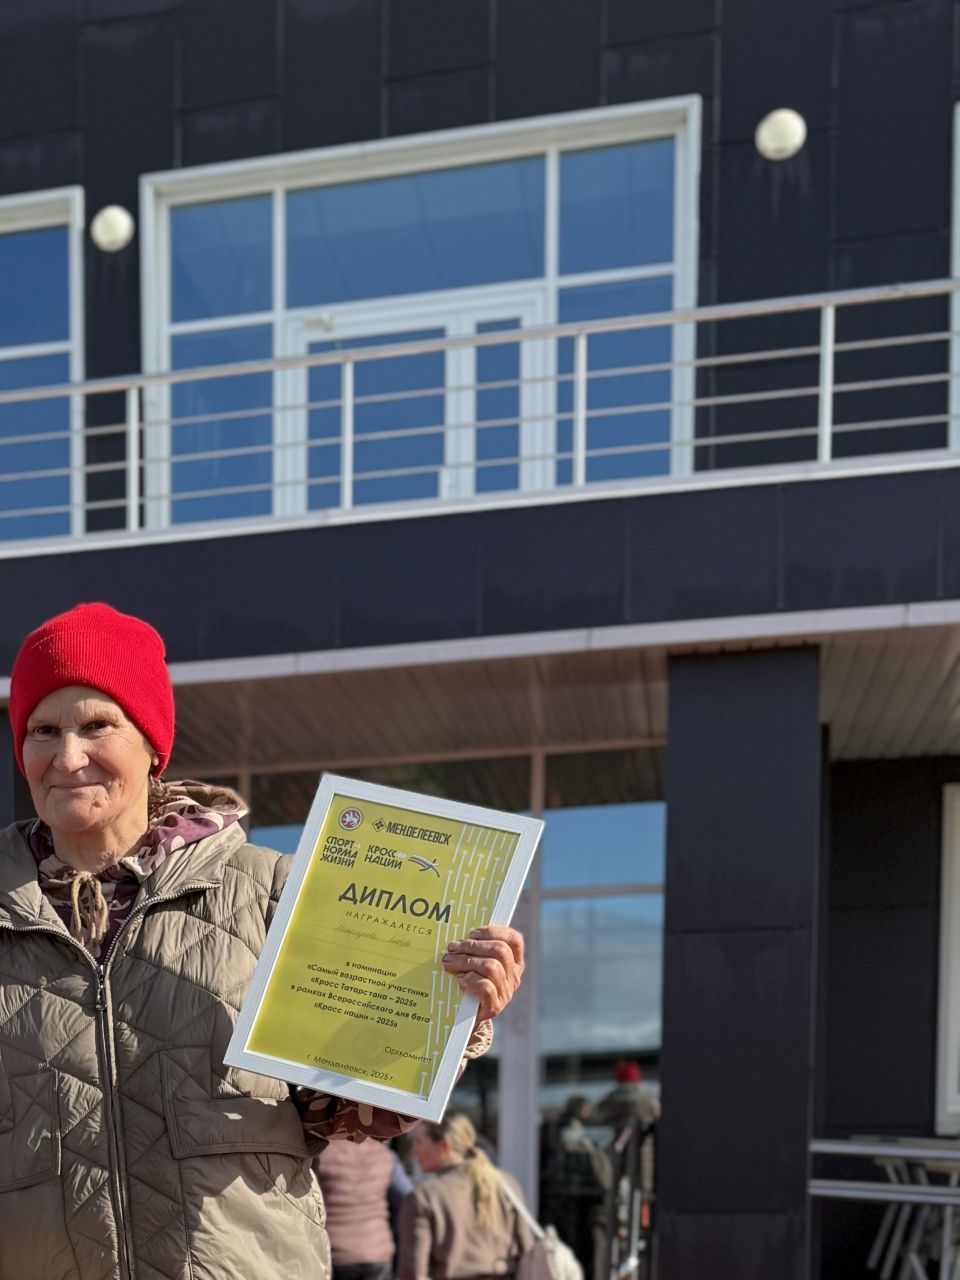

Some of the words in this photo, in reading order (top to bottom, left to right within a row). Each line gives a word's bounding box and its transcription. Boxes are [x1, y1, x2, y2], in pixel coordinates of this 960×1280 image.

[386, 822, 452, 845] МЕНДЕЛЕЕВСК
[326, 836, 355, 848] СПОРТ
[323, 844, 358, 859] НОРМА
[367, 844, 398, 858] КРОСС
[320, 853, 355, 868] ЖИЗНИ
[364, 854, 403, 870] НАЦИИ
[338, 883, 451, 923] ДИПЛОМ
[345, 910, 432, 936] НАГРАЖДАЕТСЯ
[352, 962, 397, 978] номинации
[340, 972, 386, 987] возрастной
[341, 983, 388, 1000] Татарстана
[296, 984, 326, 998] рамках
[328, 992, 394, 1014] Всероссийского
[394, 1009, 410, 1018] дня
[411, 1011, 431, 1024] бега
[344, 1009, 369, 1021] нации
[370, 1070, 388, 1081] 2025
